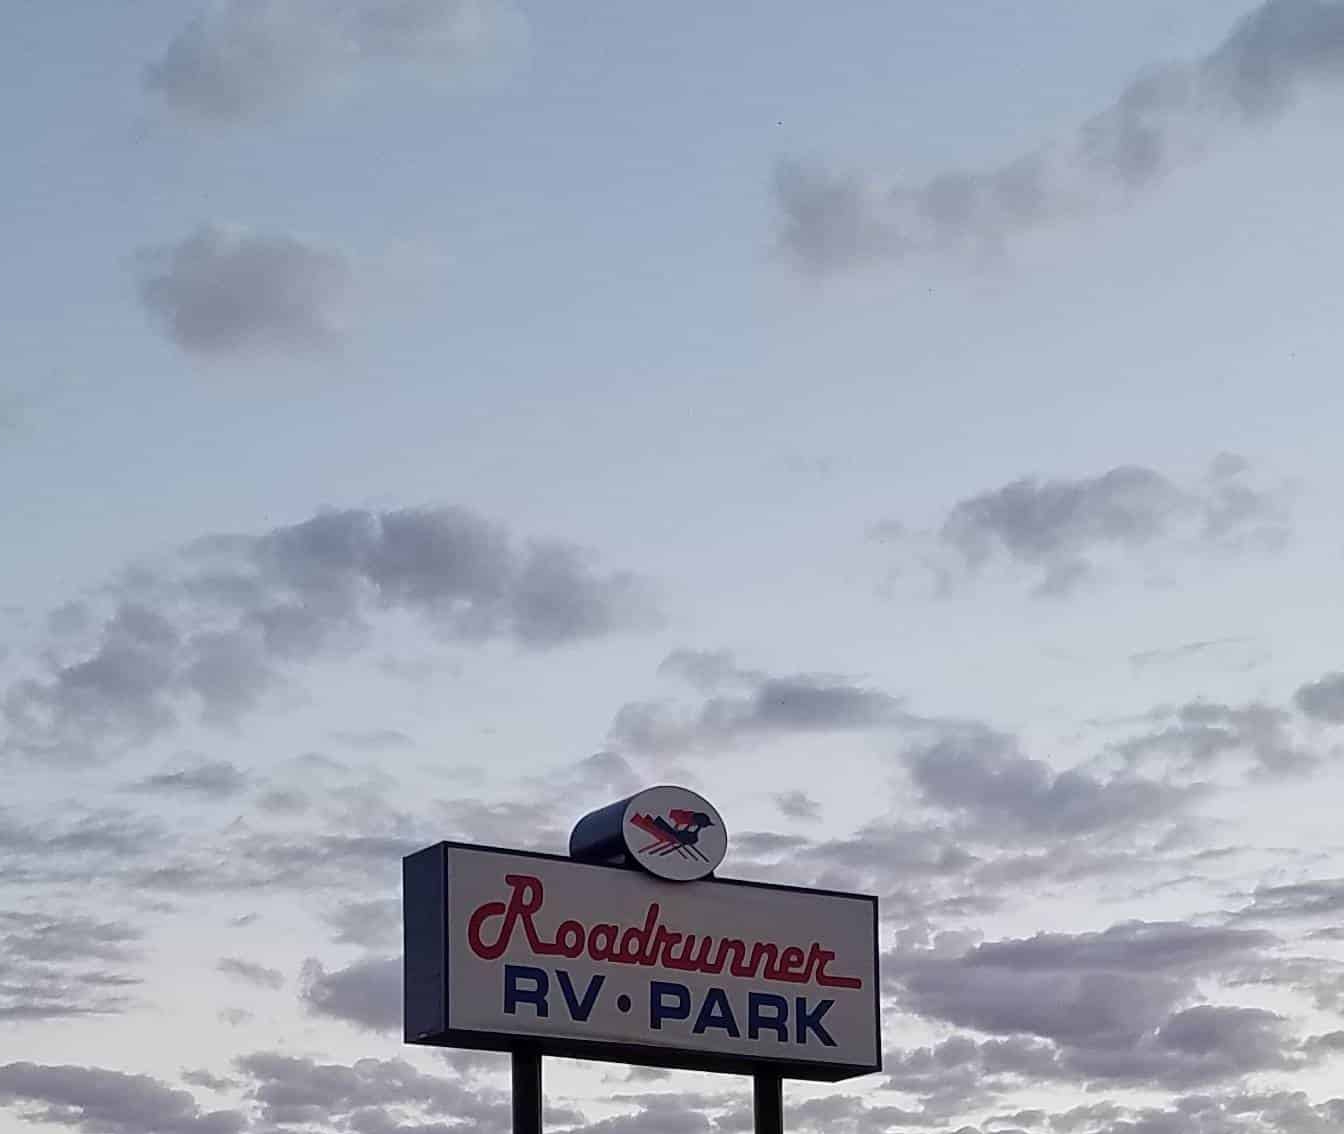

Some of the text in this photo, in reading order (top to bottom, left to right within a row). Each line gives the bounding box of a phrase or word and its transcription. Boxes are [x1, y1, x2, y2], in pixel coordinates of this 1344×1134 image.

[467, 873, 863, 989] Roadrunner
[502, 964, 838, 1048] RV PARK
